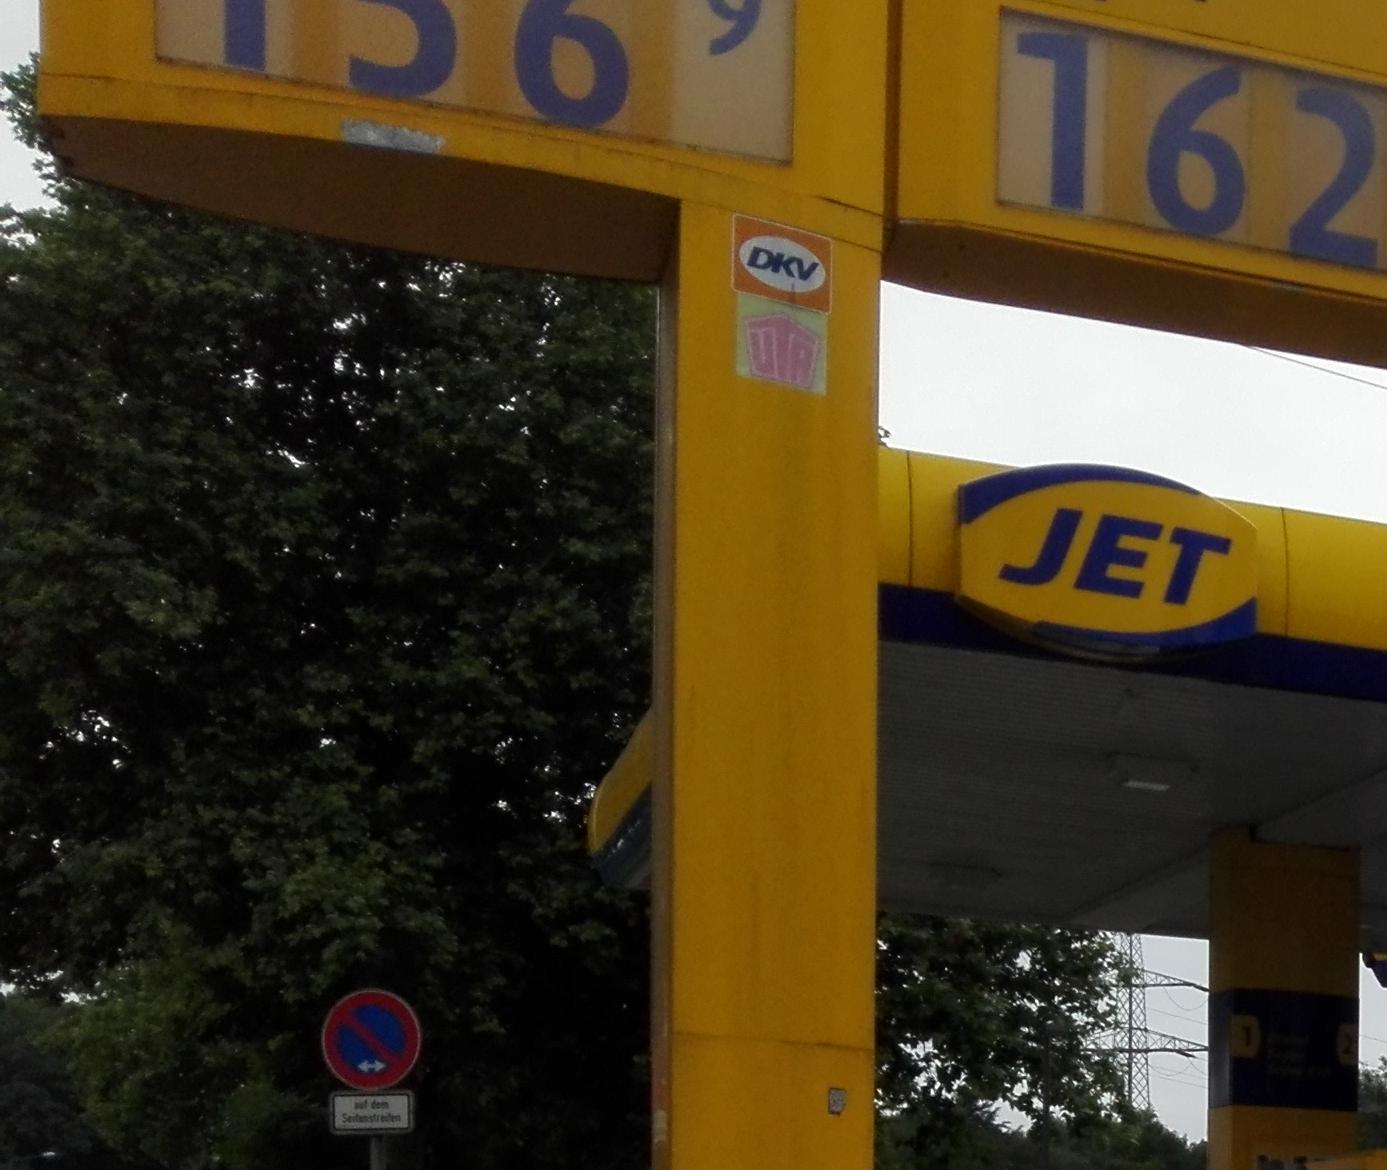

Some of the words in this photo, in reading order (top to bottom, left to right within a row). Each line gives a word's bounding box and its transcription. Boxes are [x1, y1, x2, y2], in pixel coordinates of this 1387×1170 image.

[746, 246, 819, 281] DKV
[1000, 507, 1231, 606] JET
[354, 1099, 368, 1109] auf
[371, 1099, 389, 1109] dem
[342, 1113, 401, 1123] Seitenstreifen
